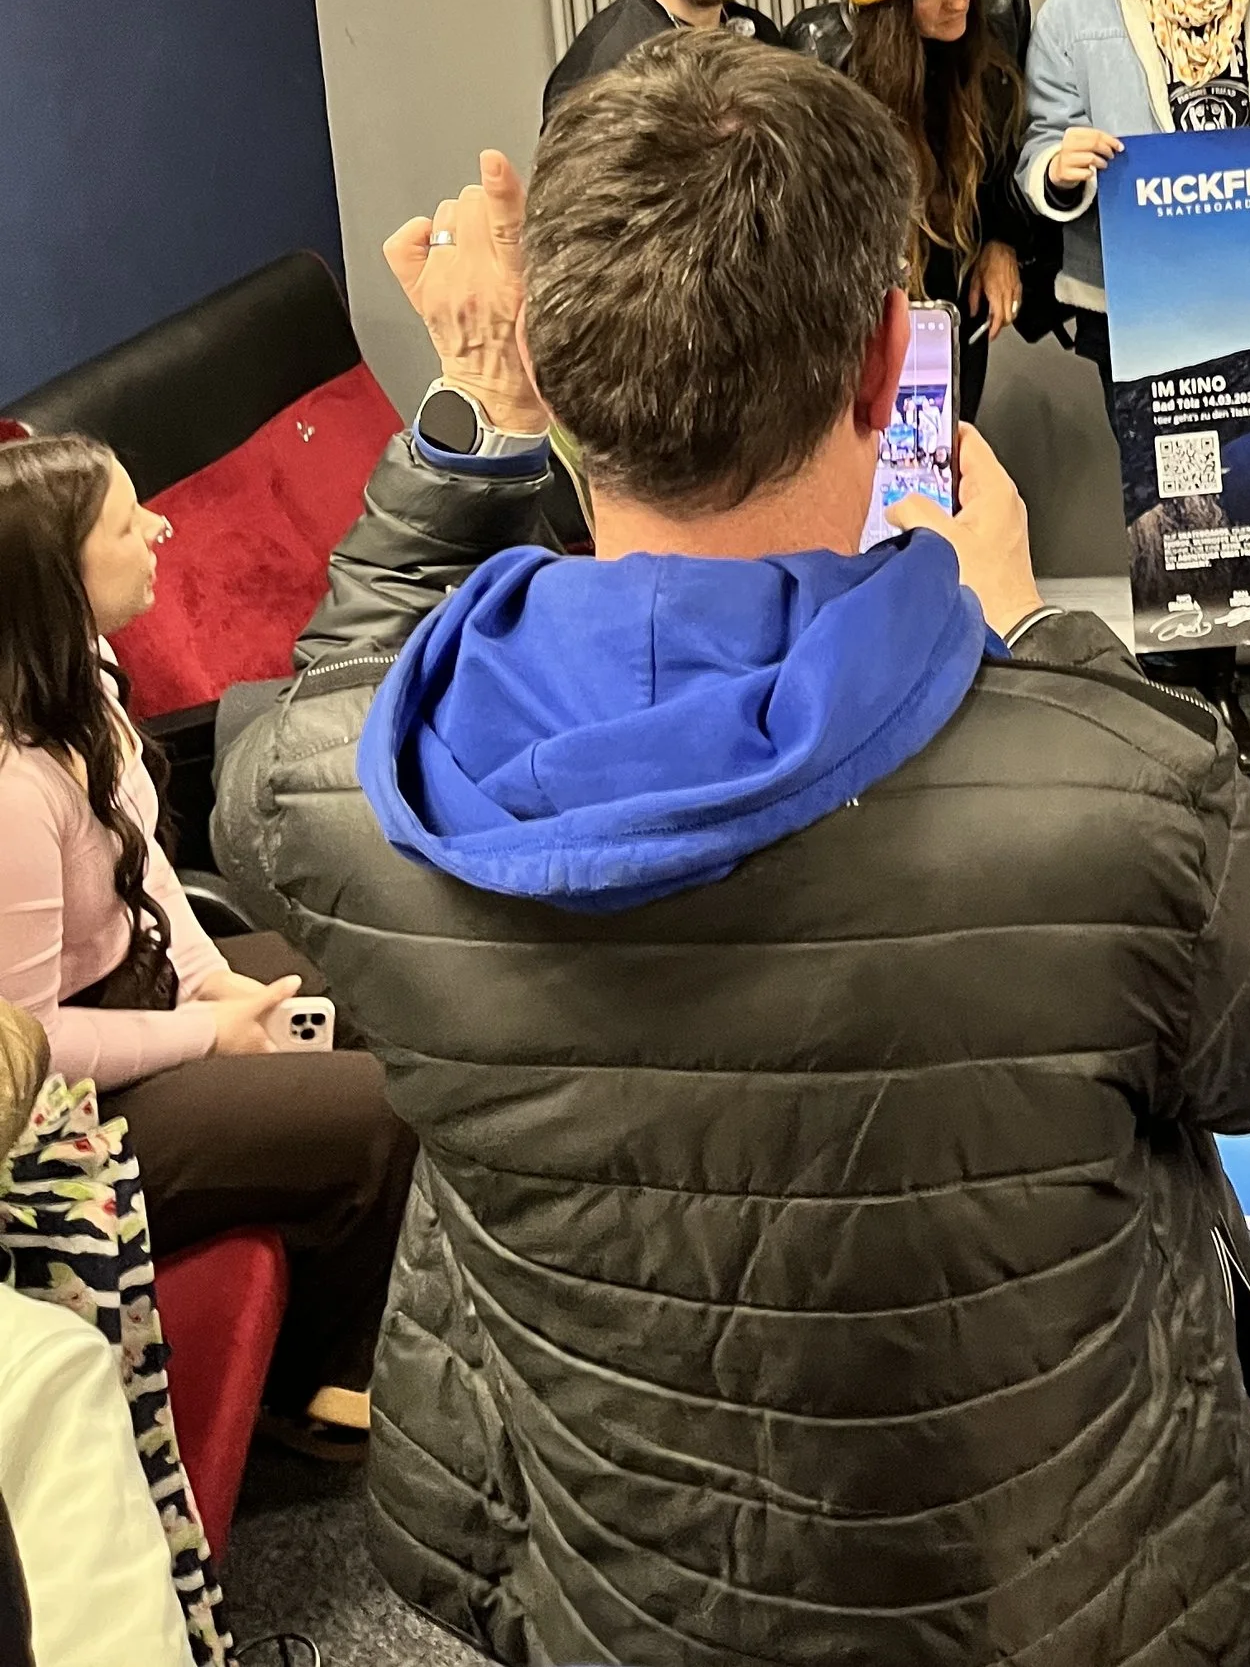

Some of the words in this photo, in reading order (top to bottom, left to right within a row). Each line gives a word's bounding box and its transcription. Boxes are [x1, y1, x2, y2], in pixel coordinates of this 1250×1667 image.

[1151, 380, 1175, 398] IM
[1179, 375, 1226, 395] KINO
[1152, 399, 1175, 413] Bad
